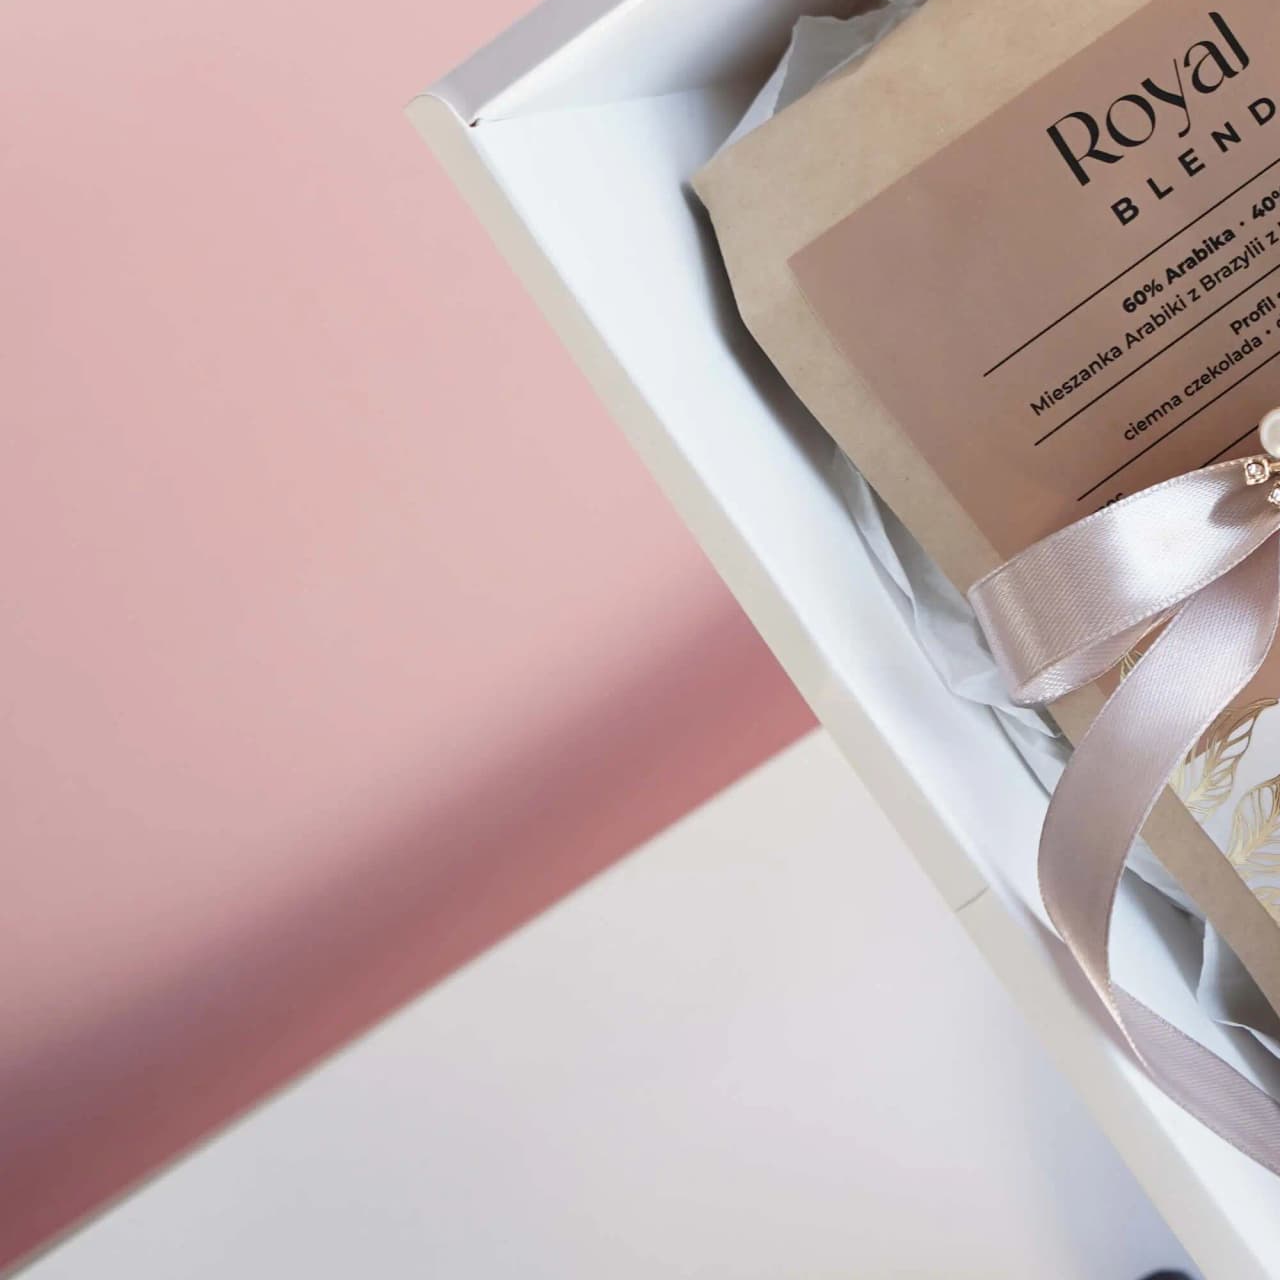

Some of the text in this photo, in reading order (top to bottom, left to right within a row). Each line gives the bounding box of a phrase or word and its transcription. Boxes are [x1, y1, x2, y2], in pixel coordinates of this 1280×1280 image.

[1046, 11, 1250, 187] Royal
[1110, 97, 1276, 227] BLEND
[1029, 345, 1124, 417] Mieszanka
[1125, 293, 1188, 350] Arabiki
[1186, 287, 1201, 303] z
[1198, 236, 1266, 292] Brazylii
[1265, 230, 1280, 246] z
[1122, 278, 1164, 314] 60%
[1165, 228, 1237, 285] Arabika
[1229, 295, 1277, 336] Profil
[1123, 394, 1184, 441] ciemna
[1183, 336, 1263, 397] czekolada
